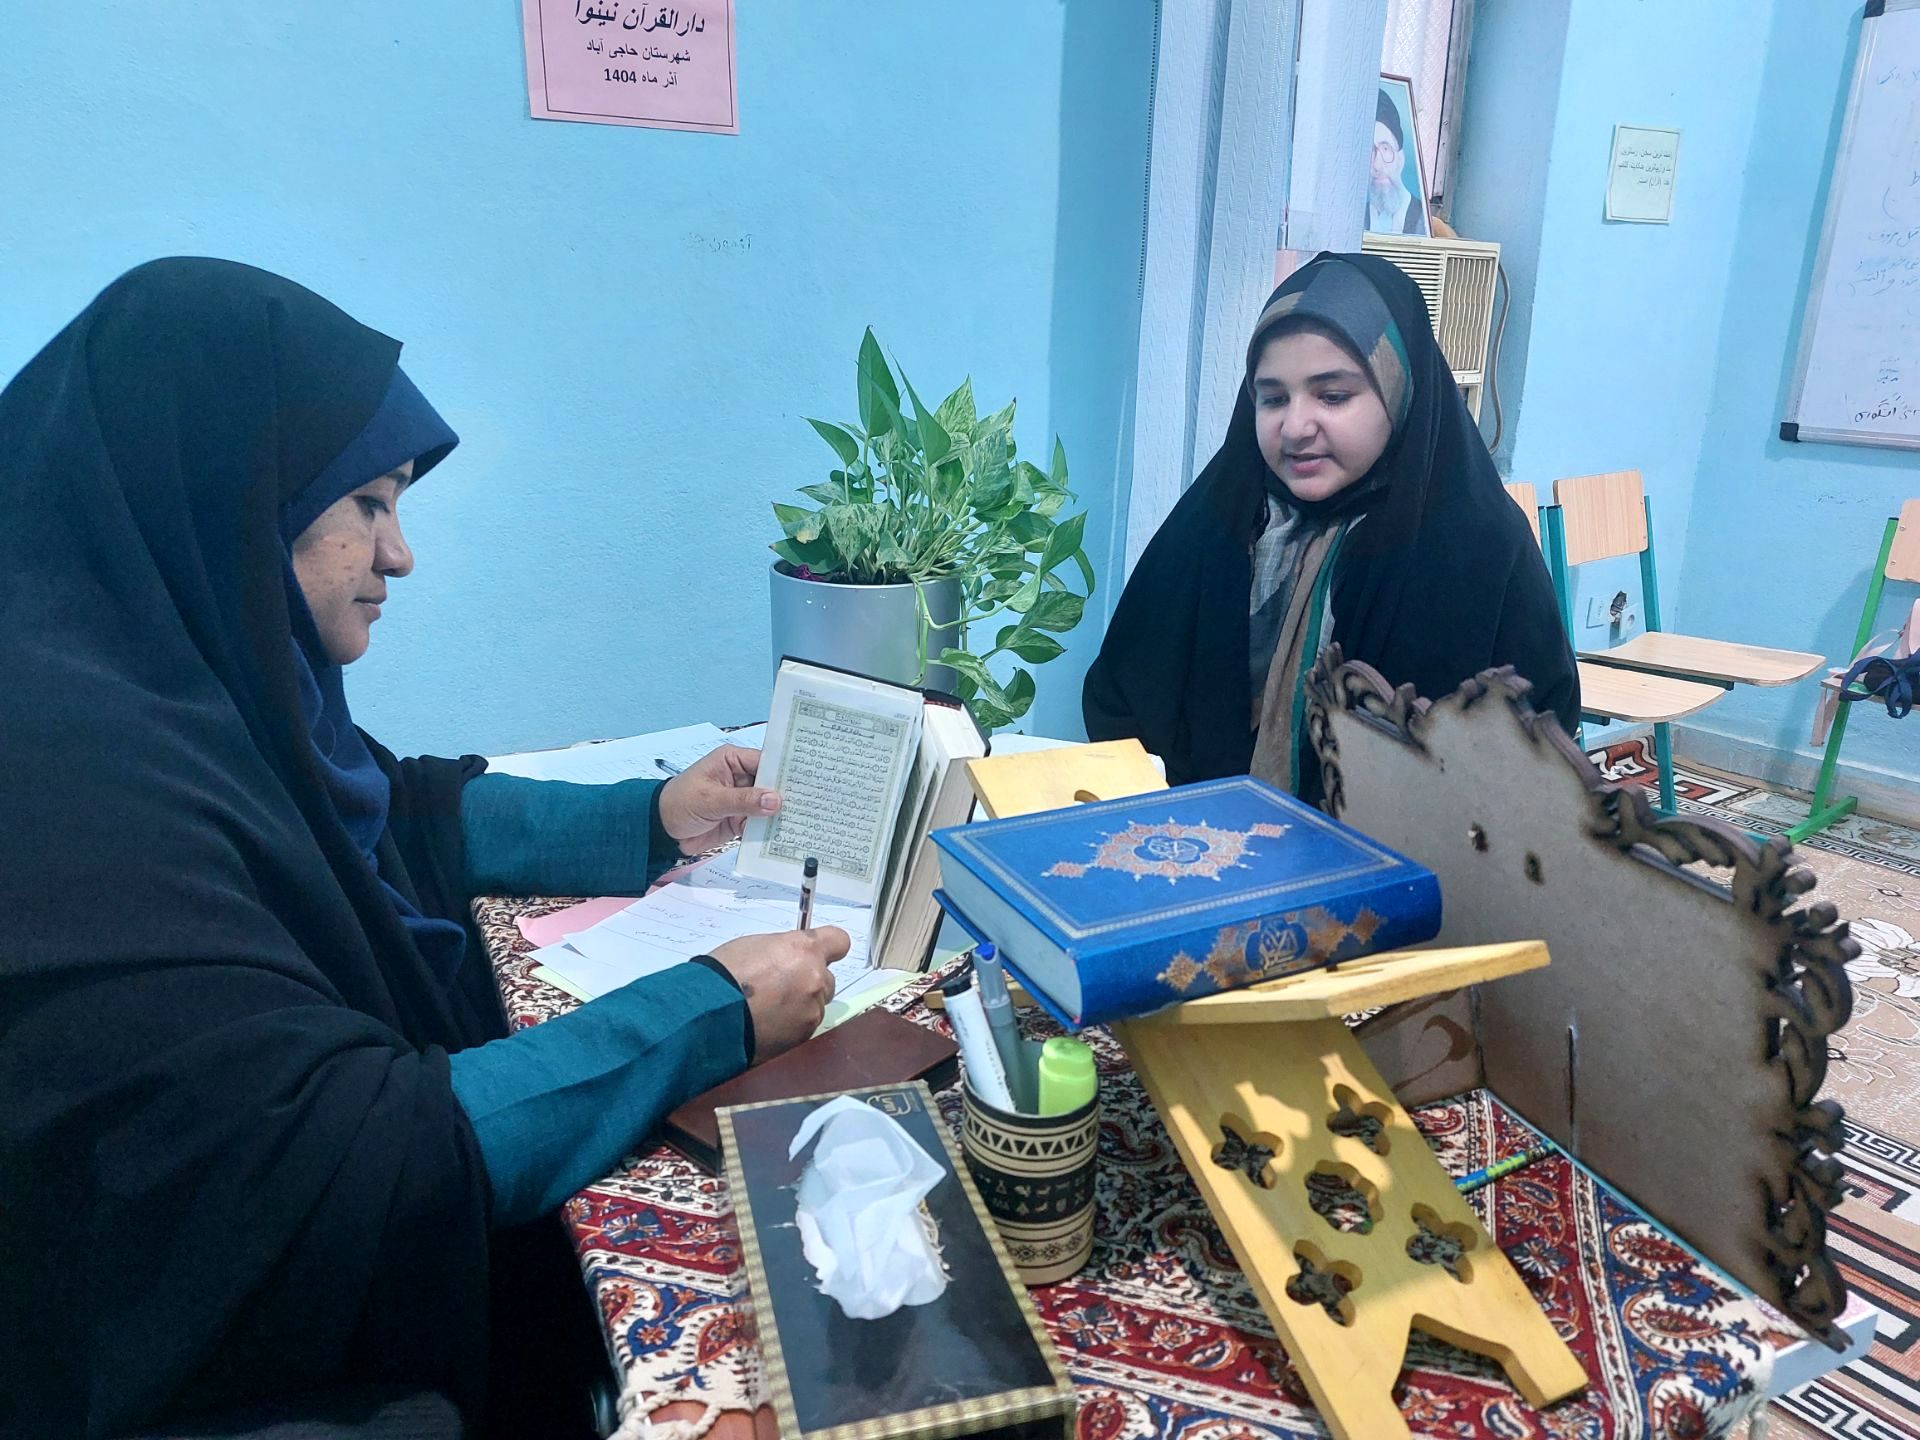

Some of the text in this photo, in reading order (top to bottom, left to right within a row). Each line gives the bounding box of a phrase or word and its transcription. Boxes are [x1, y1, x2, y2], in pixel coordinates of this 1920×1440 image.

[575, 0, 618, 24] نینوا
[586, 38, 691, 64] شهرستان حاجی آباد
[603, 68, 678, 88] آذر ماه 1404
